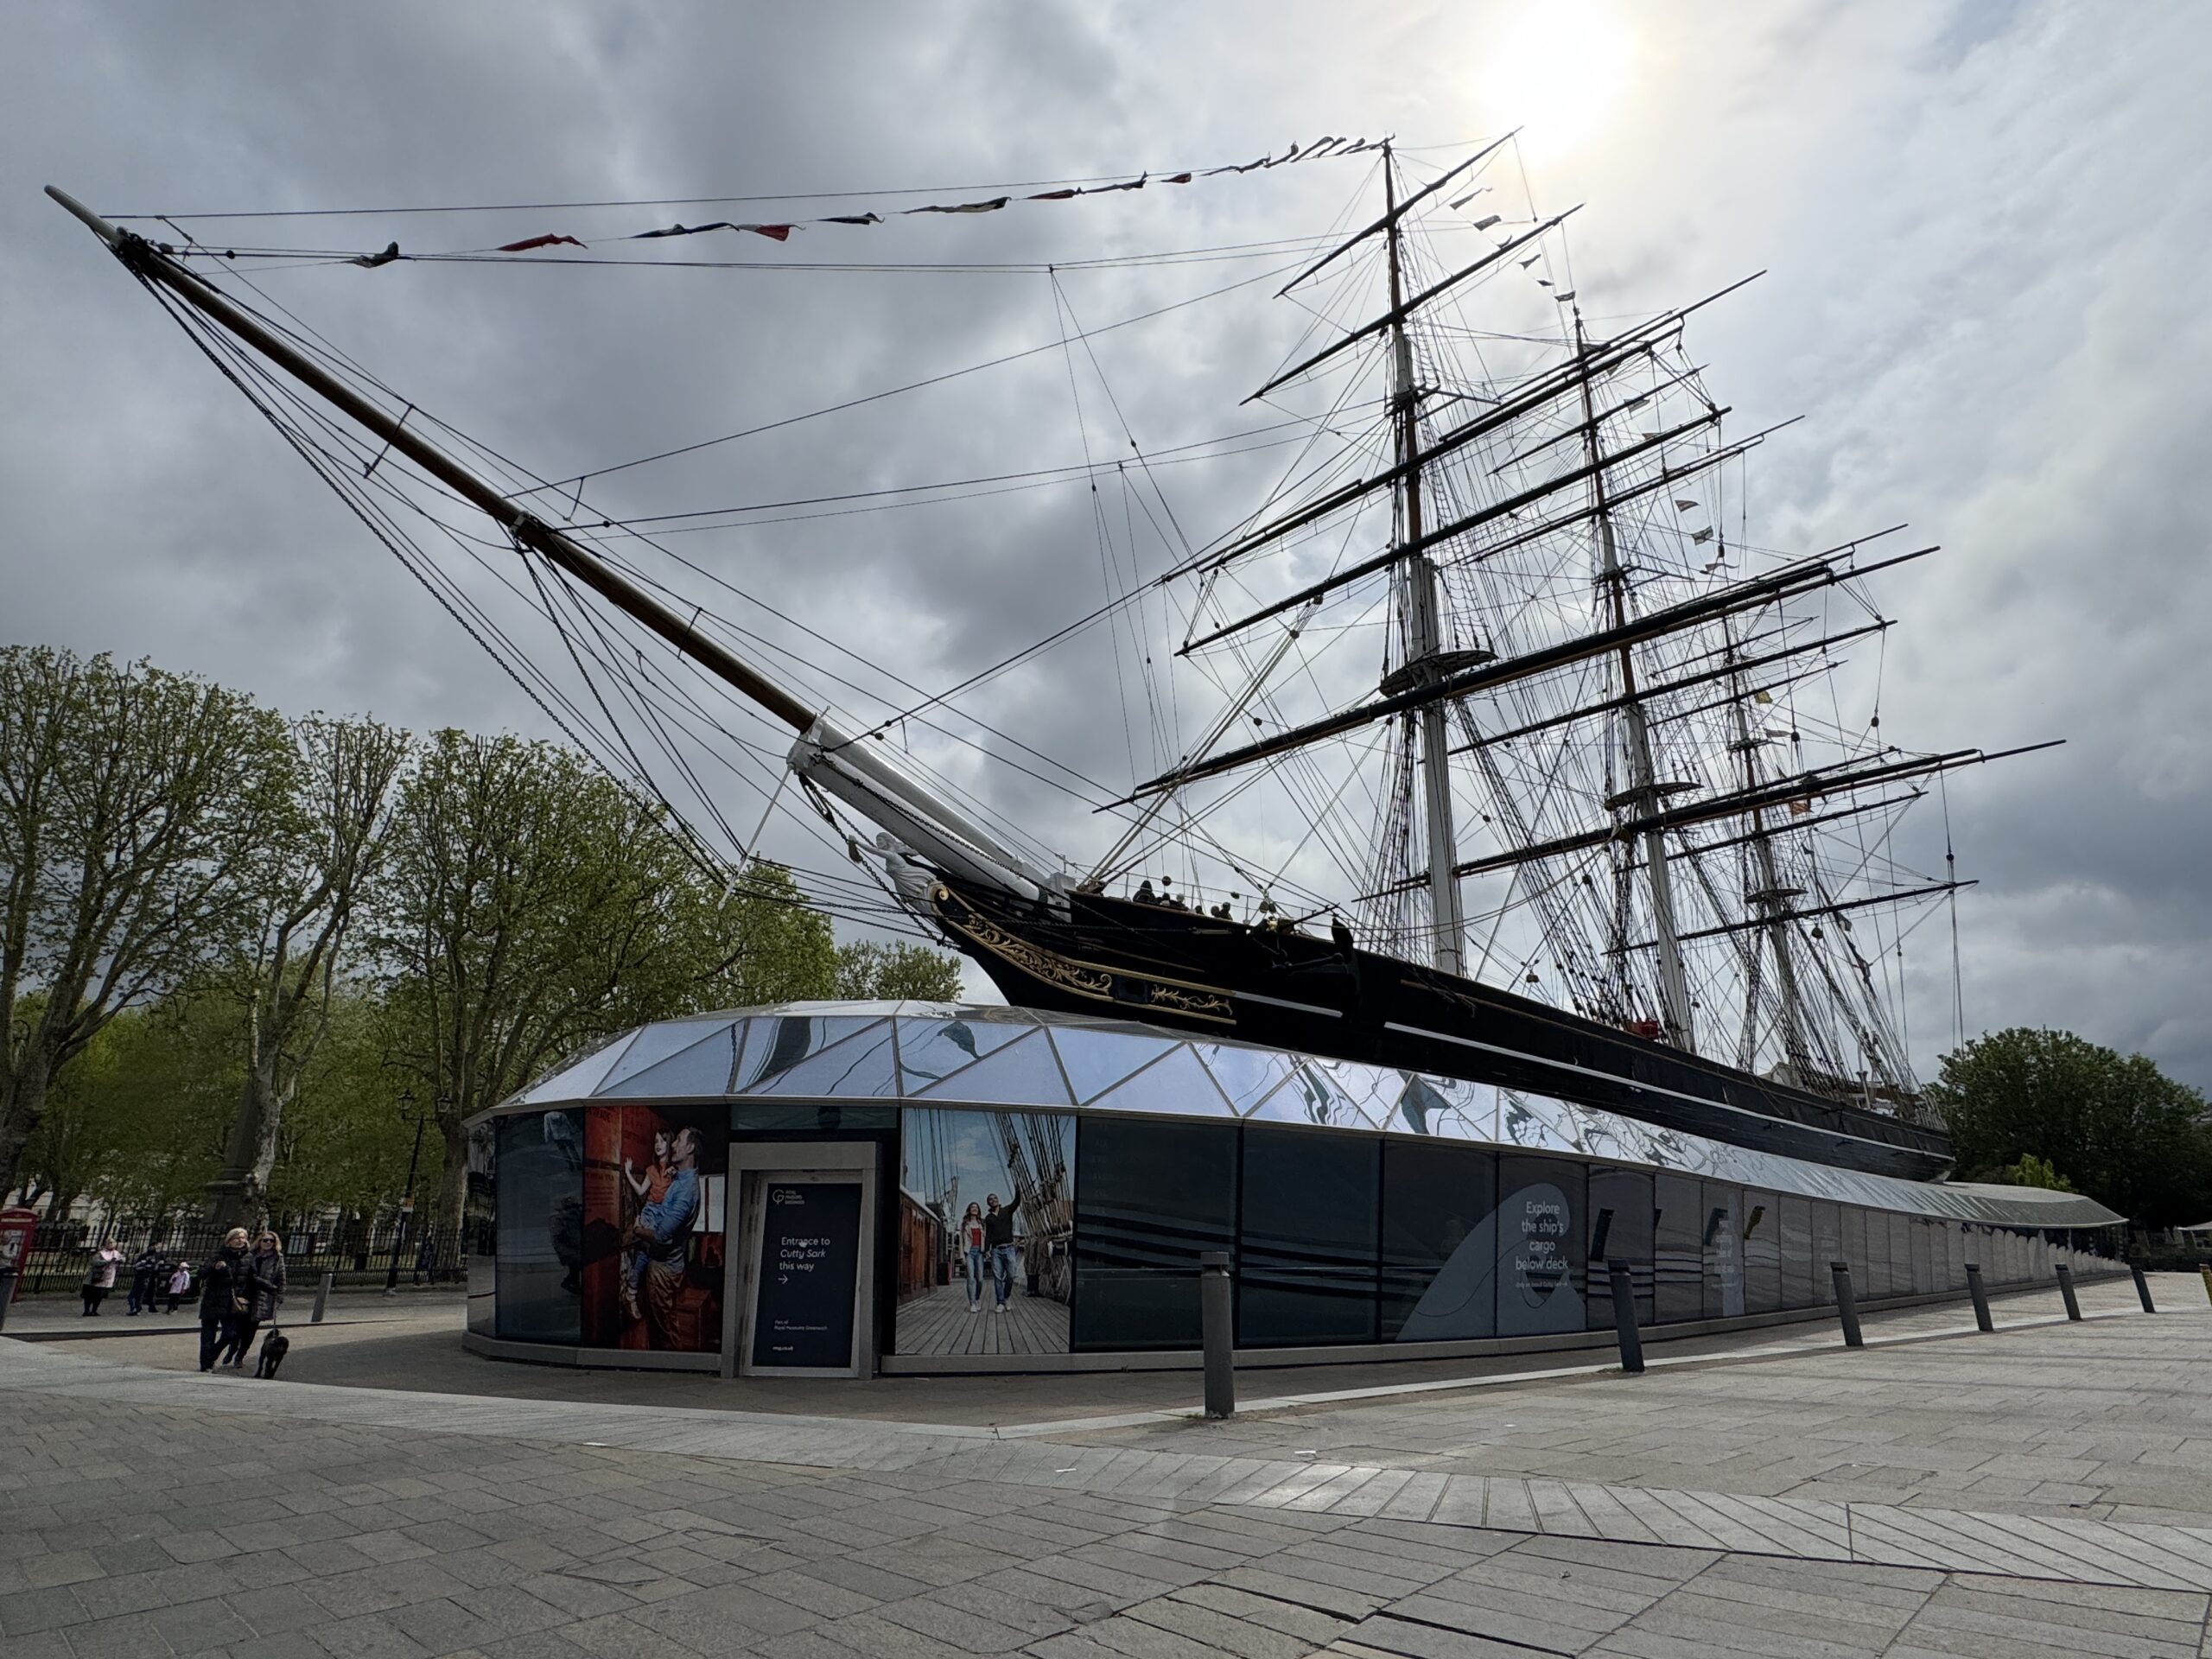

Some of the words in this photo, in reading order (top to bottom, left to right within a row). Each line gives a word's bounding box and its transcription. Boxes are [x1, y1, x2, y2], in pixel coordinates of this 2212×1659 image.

[1526, 1199, 1560, 1217] Explore
[1522, 1218, 1537, 1233] the
[1538, 1218, 1564, 1236] ship's
[781, 1236, 819, 1247] Entrance
[821, 1237, 831, 1246] to
[1529, 1241, 1556, 1255] cargo
[780, 1249, 804, 1260] Cutty
[806, 1248, 827, 1258] Sark
[779, 1260, 795, 1270] this
[797, 1262, 815, 1273] way
[1515, 1255, 1544, 1271] below
[1546, 1255, 1569, 1270] deck
